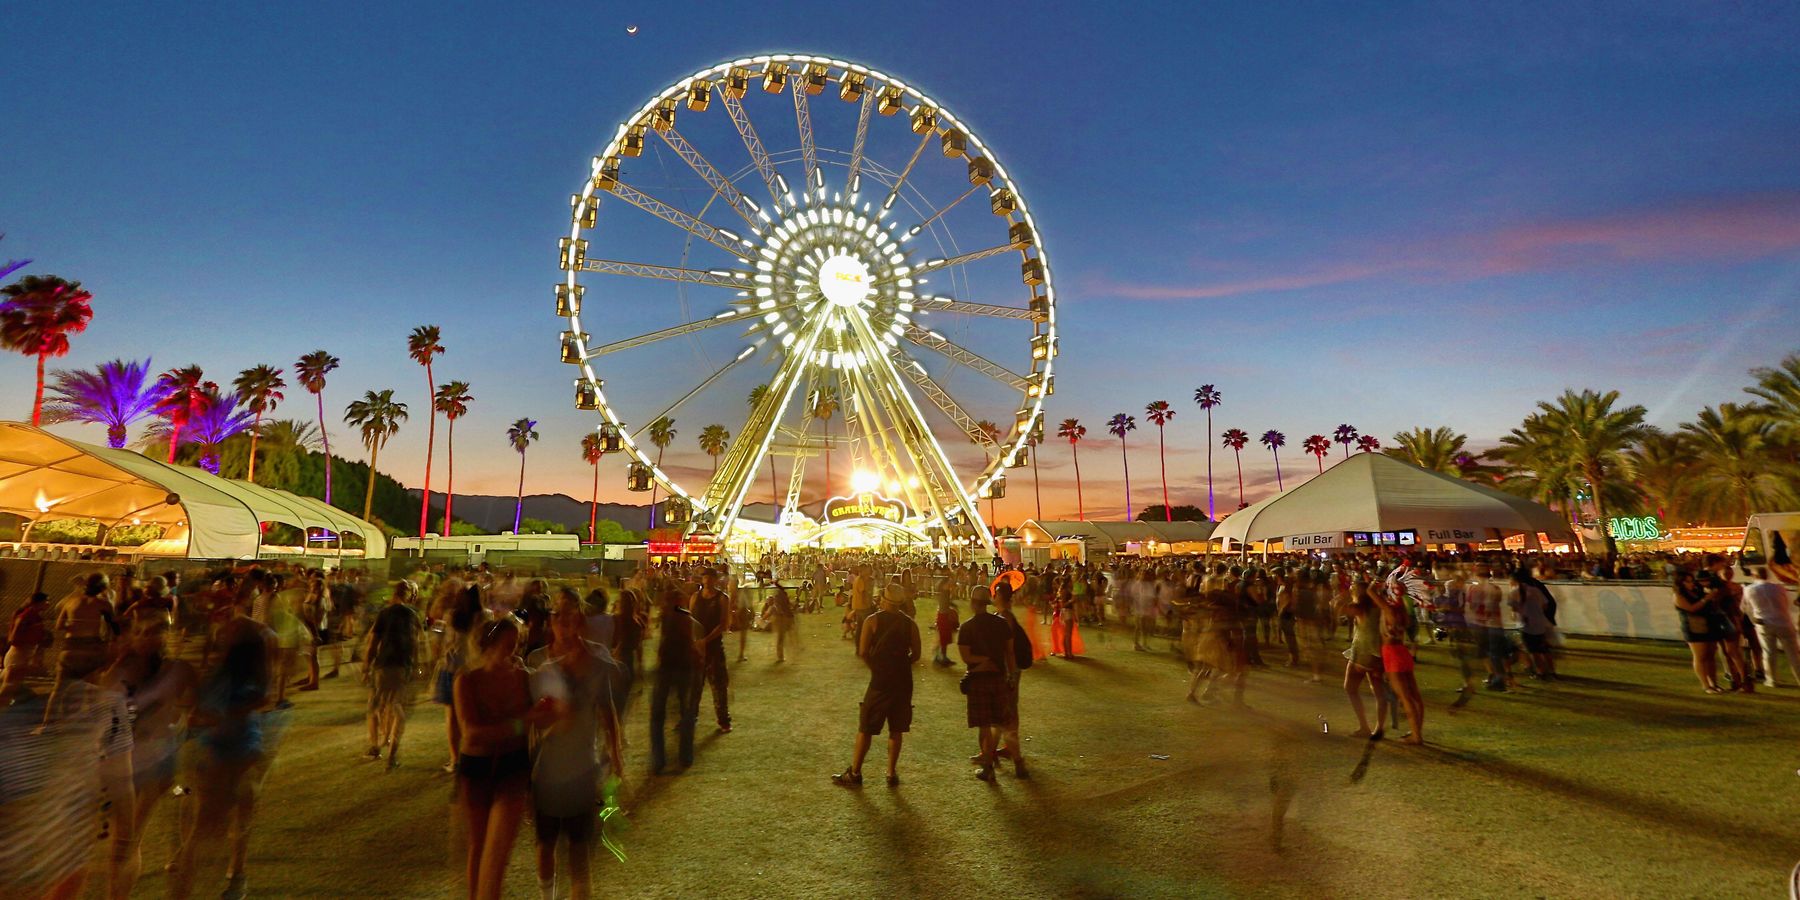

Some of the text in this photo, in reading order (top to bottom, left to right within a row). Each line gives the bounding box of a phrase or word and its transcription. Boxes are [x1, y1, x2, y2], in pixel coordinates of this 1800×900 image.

[1608, 516, 1659, 539] ACOS
[1428, 529, 1474, 540] Full Bar
[1292, 535, 1333, 546] Full Bar
